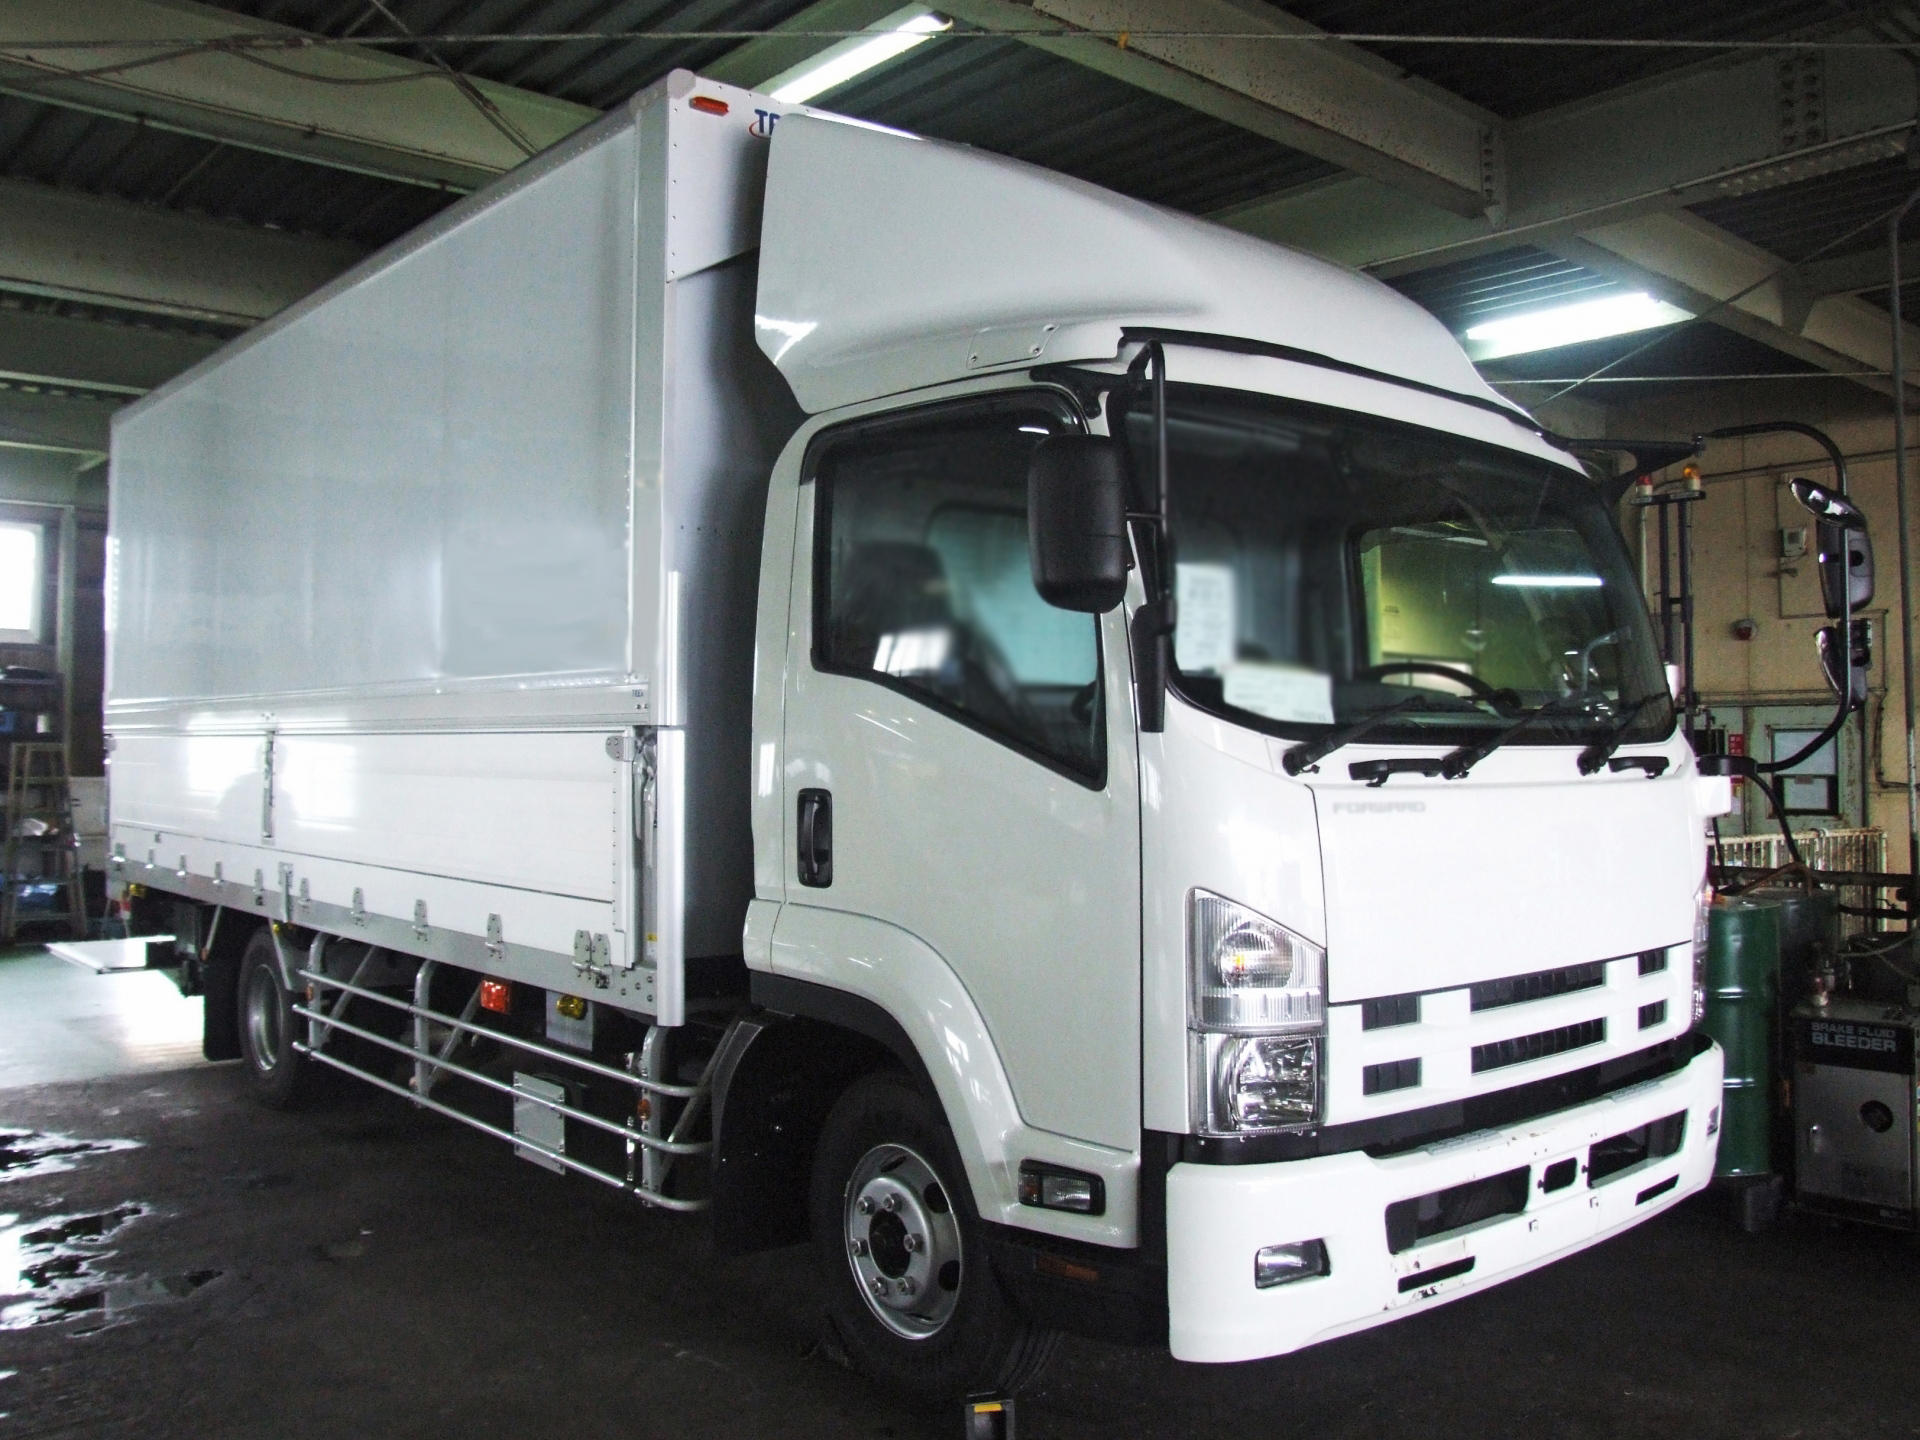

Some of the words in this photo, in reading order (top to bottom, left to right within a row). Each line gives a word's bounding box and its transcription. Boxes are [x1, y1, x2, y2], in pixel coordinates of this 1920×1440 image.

[1332, 801, 1426, 814] FORWARD
[1812, 1021, 1854, 1034] BRAKE
[1858, 1026, 1896, 1038] FLUID
[1812, 1032, 1896, 1052] BLEEDER
